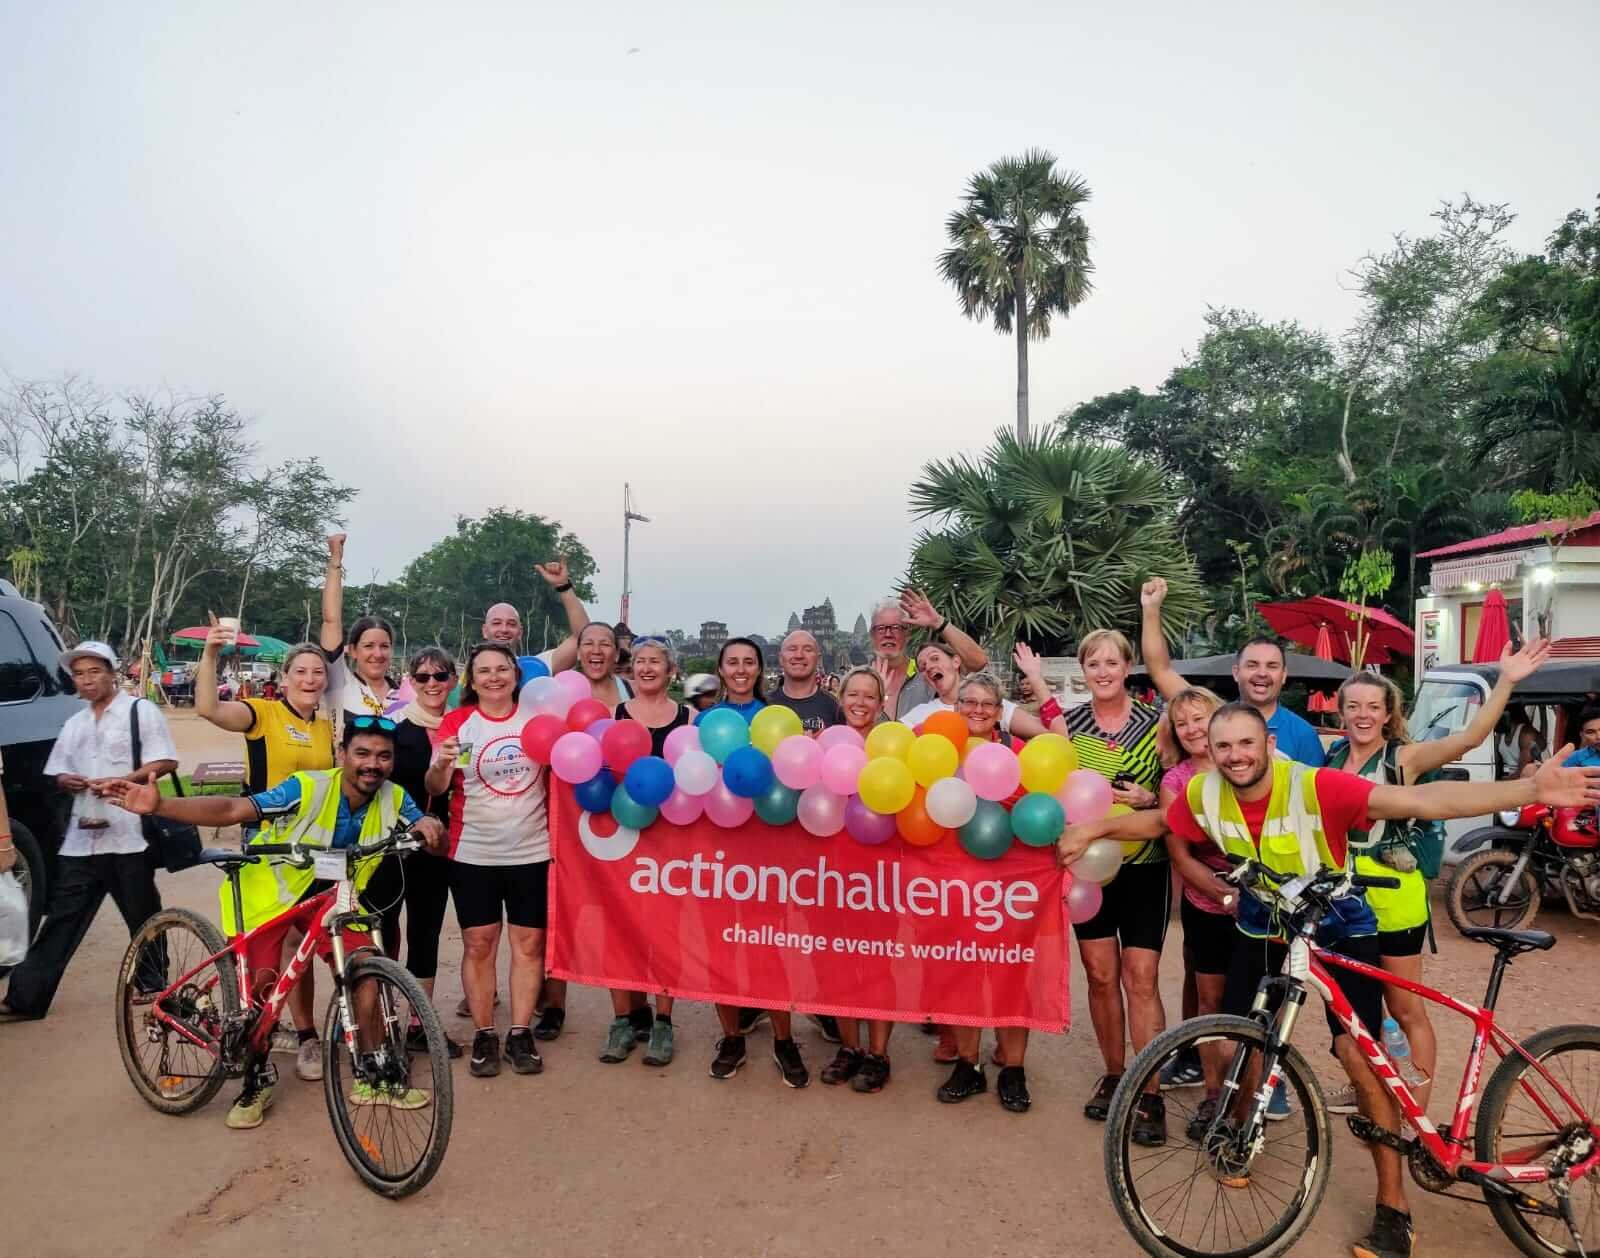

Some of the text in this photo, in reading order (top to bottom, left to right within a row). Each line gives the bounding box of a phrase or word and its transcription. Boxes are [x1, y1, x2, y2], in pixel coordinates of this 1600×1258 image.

[502, 766, 530, 775] DELTA
[628, 850, 1039, 932] actionchallenge
[722, 924, 1036, 964] challenge events worldwide
